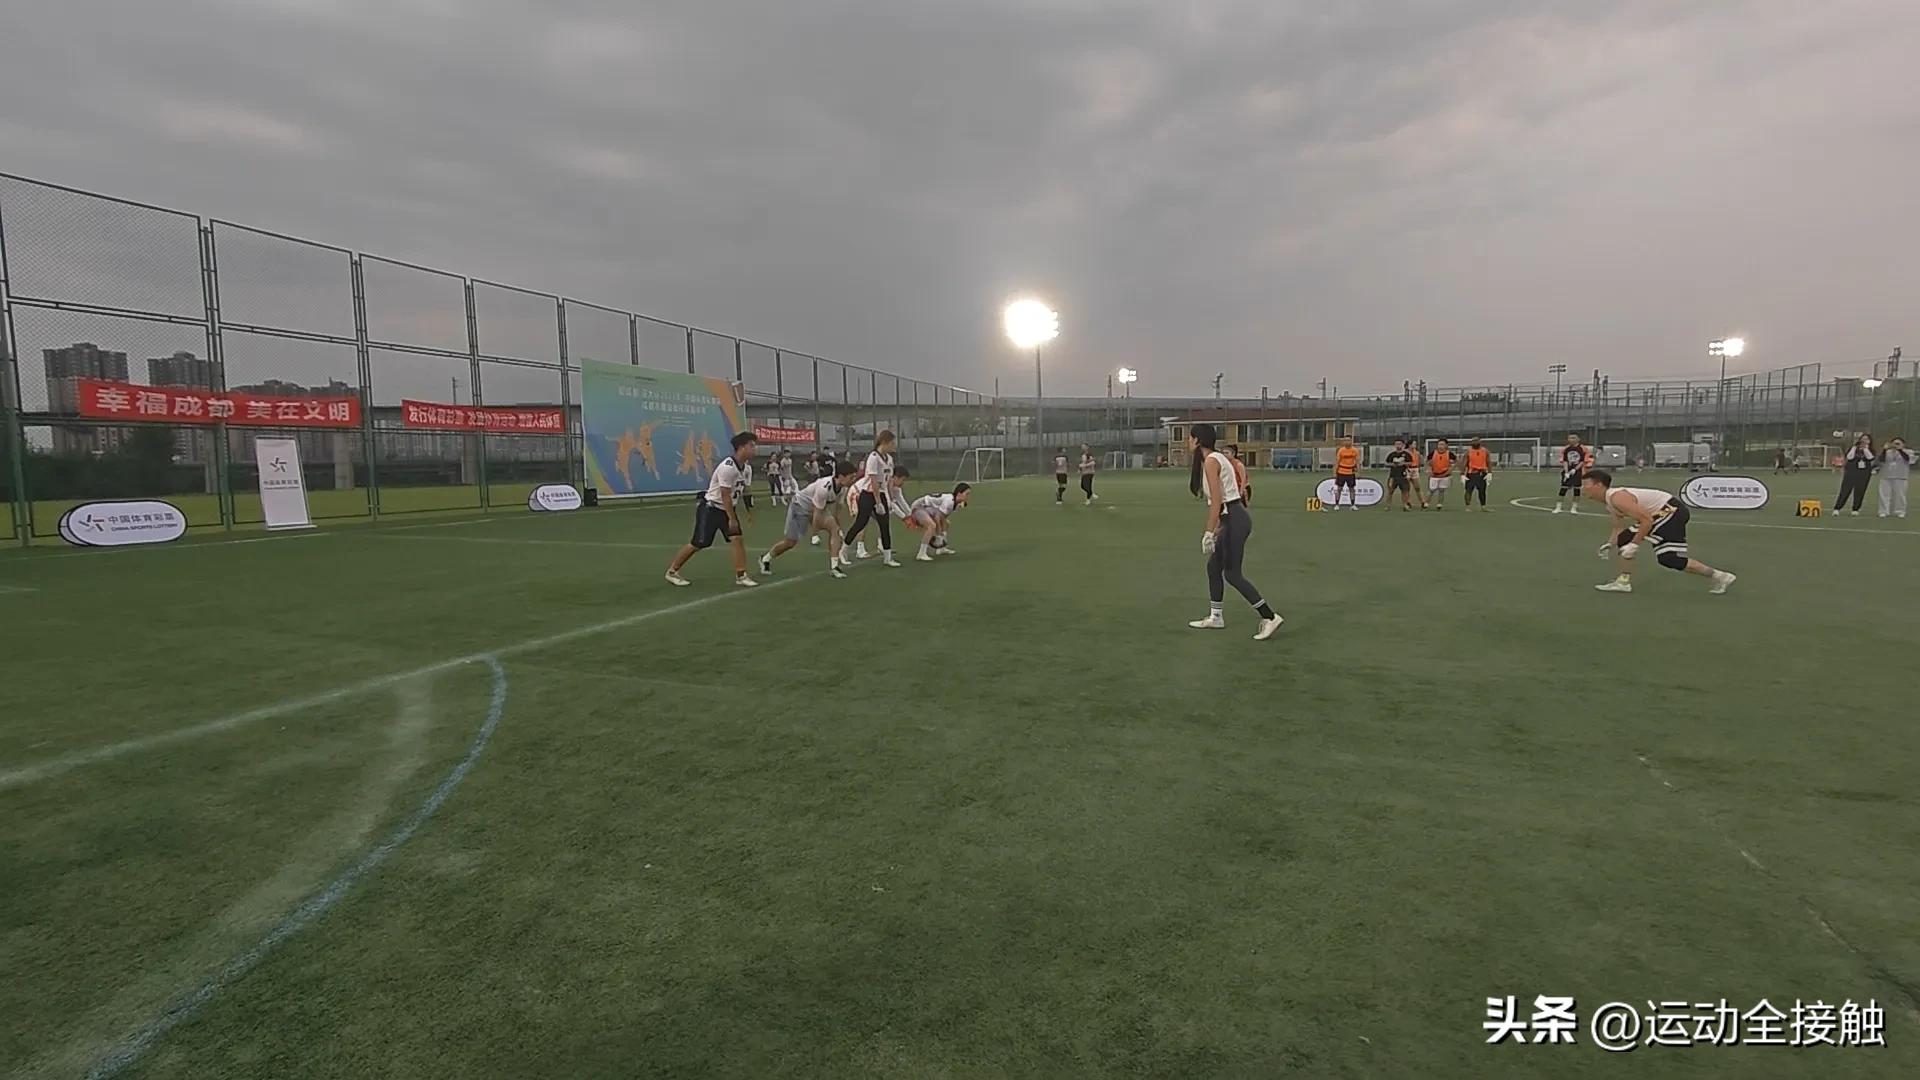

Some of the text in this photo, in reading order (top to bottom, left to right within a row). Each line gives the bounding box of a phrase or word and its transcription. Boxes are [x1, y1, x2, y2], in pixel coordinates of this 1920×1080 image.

[95, 386, 351, 422] 幸福成都 美在文明
[1308, 498, 1320, 510] 10
[1801, 506, 1820, 518] 20
[108, 512, 175, 525] 中国体育彩票
